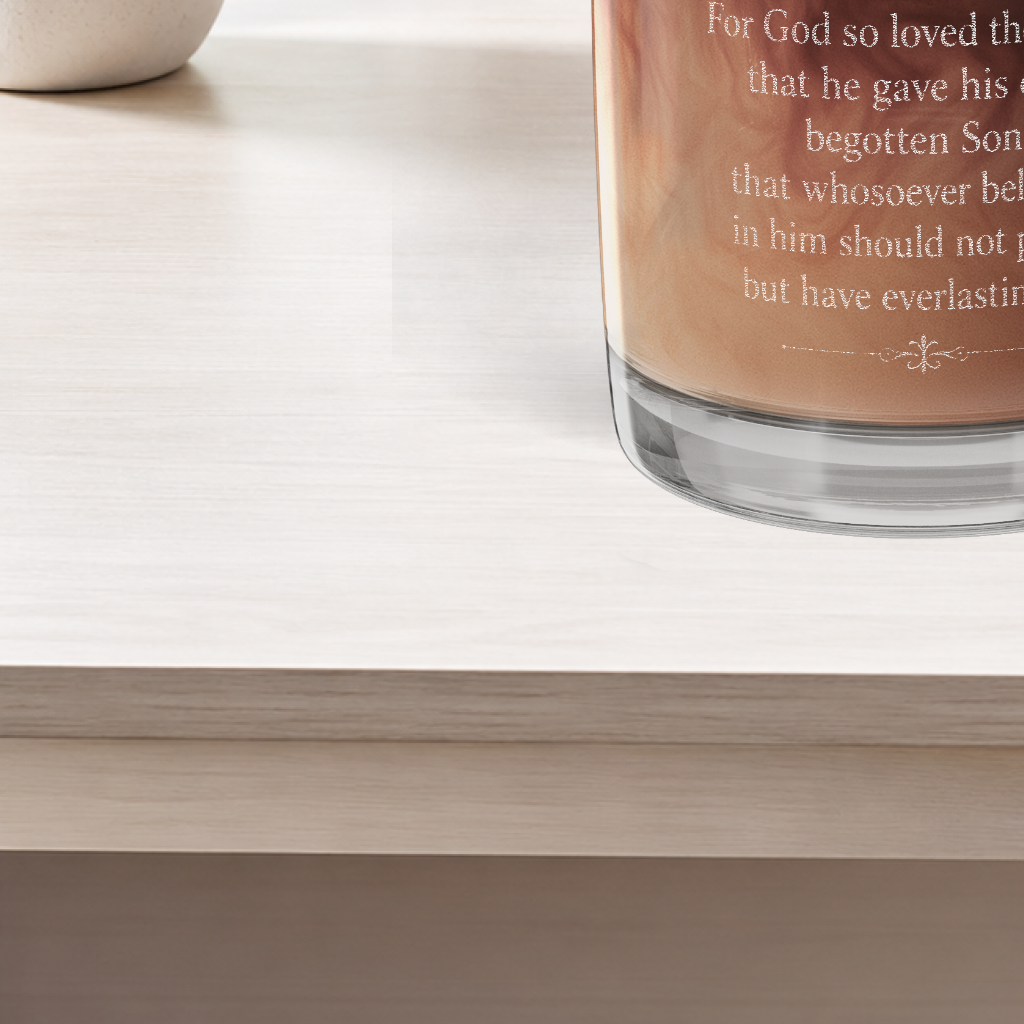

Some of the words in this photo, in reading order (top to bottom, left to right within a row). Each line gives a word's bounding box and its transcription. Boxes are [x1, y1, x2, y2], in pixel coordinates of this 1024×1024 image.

[708, 2, 754, 38] For
[764, 9, 831, 45] God
[843, 25, 878, 47] so
[890, 11, 977, 48] loved
[747, 61, 809, 98] that
[821, 66, 860, 101] he
[873, 80, 947, 111] gave
[961, 67, 1008, 100] his
[806, 118, 949, 162] begotten
[732, 163, 790, 199] that
[802, 171, 971, 206] whosoever
[734, 215, 759, 247] in
[770, 218, 827, 254] him
[840, 225, 944, 258] should
[957, 228, 1007, 256] not
[744, 267, 789, 303] but
[801, 274, 870, 309] have
